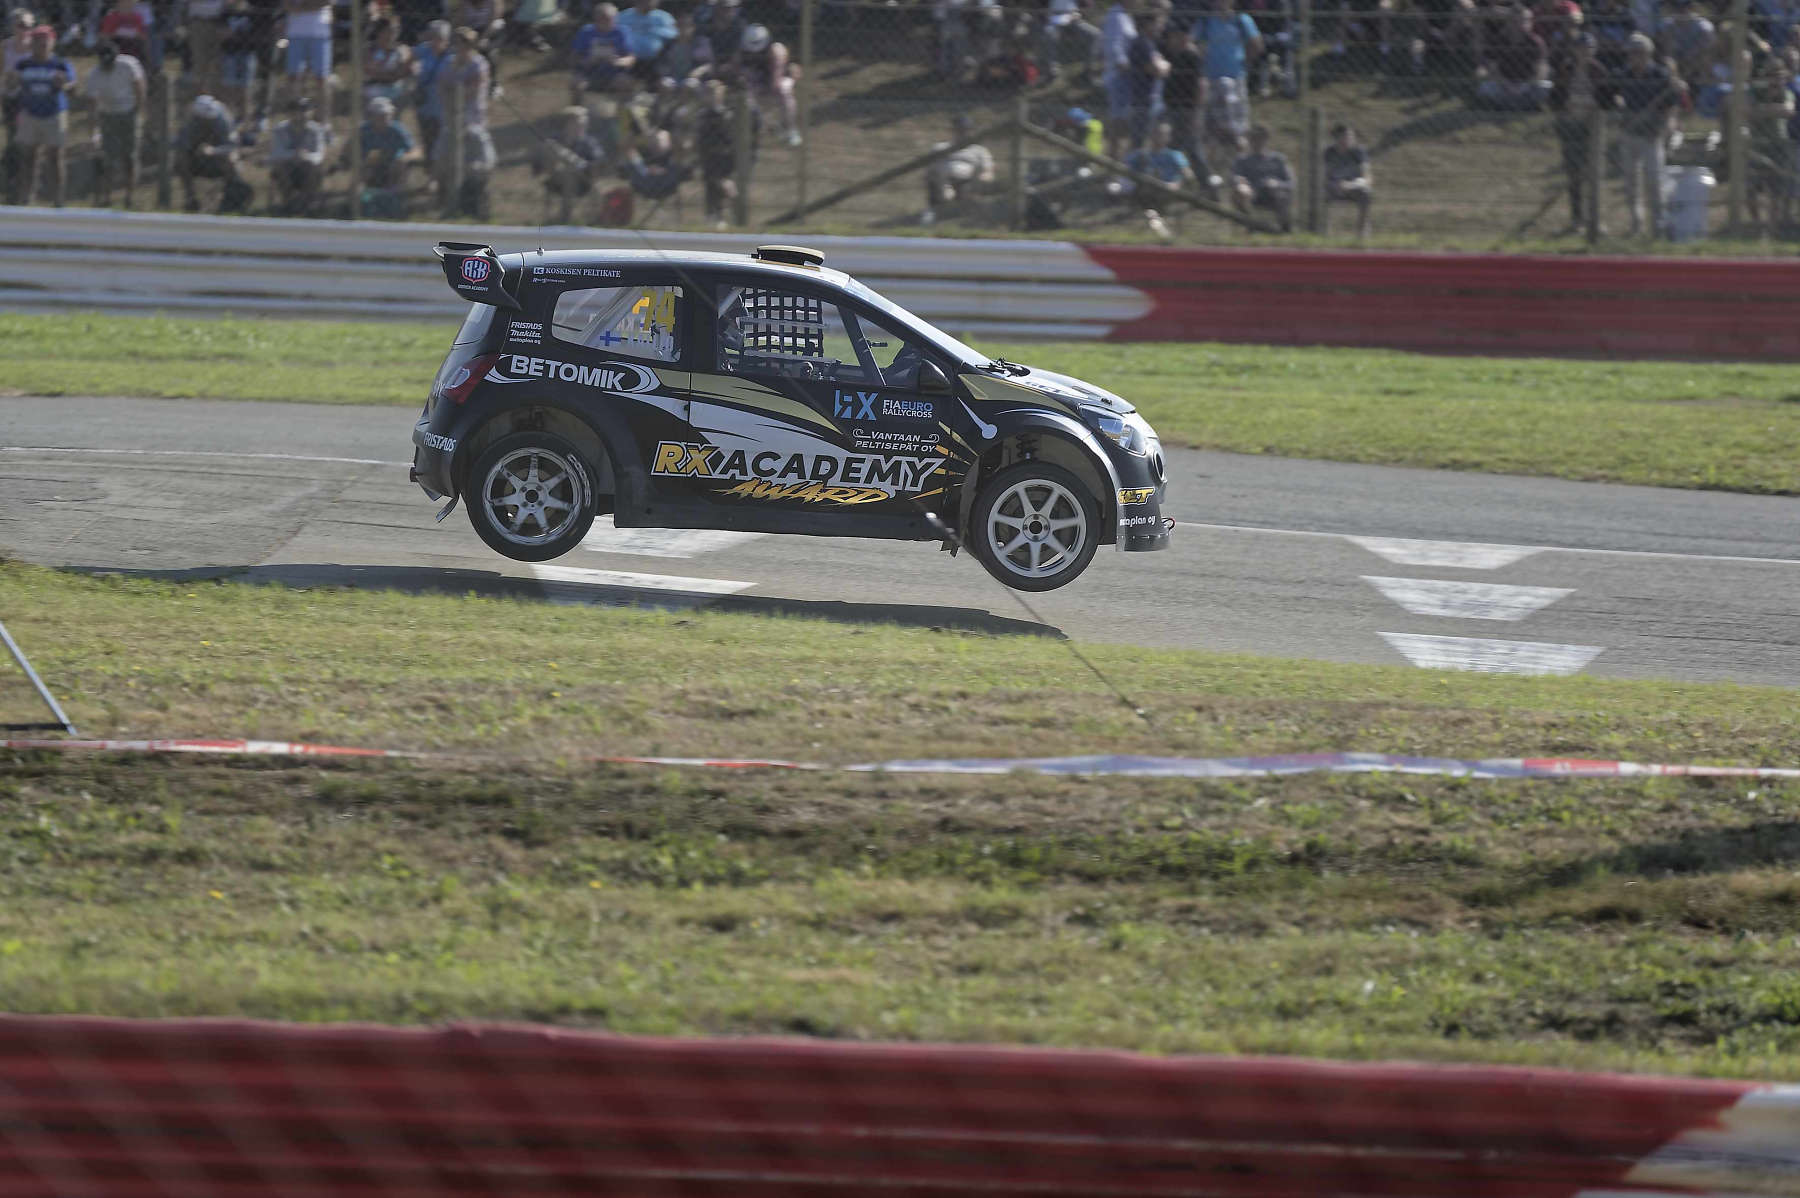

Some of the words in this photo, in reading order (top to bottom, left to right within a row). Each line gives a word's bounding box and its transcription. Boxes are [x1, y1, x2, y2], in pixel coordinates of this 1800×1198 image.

[583, 269, 621, 277] PELTIKATE
[511, 322, 543, 330] FRISTADS
[511, 355, 626, 391] BETOMIK
[882, 409, 933, 418] RALLYCROSS
[871, 431, 921, 442] VANTAAN
[855, 441, 919, 451] PELTISEPÄT
[718, 478, 891, 504] AWARD
